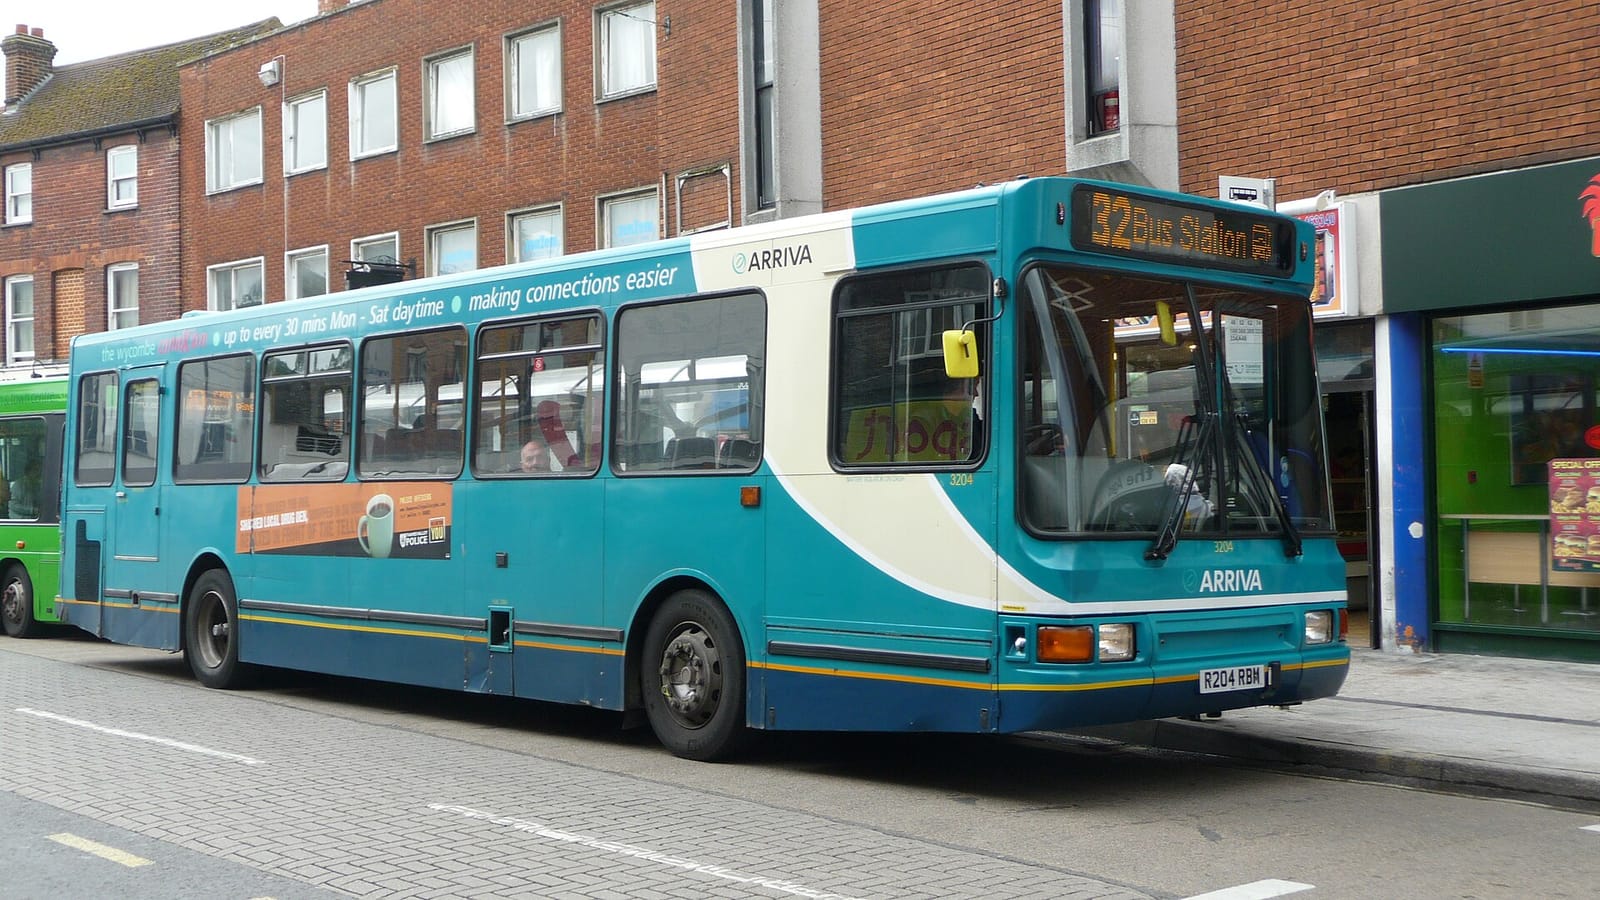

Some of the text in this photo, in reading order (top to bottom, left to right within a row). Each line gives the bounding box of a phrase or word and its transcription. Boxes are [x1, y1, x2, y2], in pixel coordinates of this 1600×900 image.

[1091, 191, 1248, 259] 32 Bus Station
[748, 244, 812, 272] ARRIVA
[468, 263, 678, 312] making connections easier
[102, 346, 114, 361] the
[117, 341, 156, 362] wycombe
[224, 330, 237, 348] up
[240, 326, 250, 342] to
[253, 323, 281, 342] every
[284, 317, 298, 336] 30
[301, 314, 326, 333] mins
[329, 310, 357, 330] Mon
[369, 302, 388, 324] Sat
[392, 296, 444, 323] daytime
[1551, 461, 1585, 469] SPECIAL
[950, 473, 973, 486] 3204
[406, 535, 428, 546] POLICE
[431, 526, 444, 540] YOU
[1214, 540, 1234, 553] 3204
[1199, 569, 1263, 593] ARRIVA
[1204, 666, 1261, 689] R204 RBM
